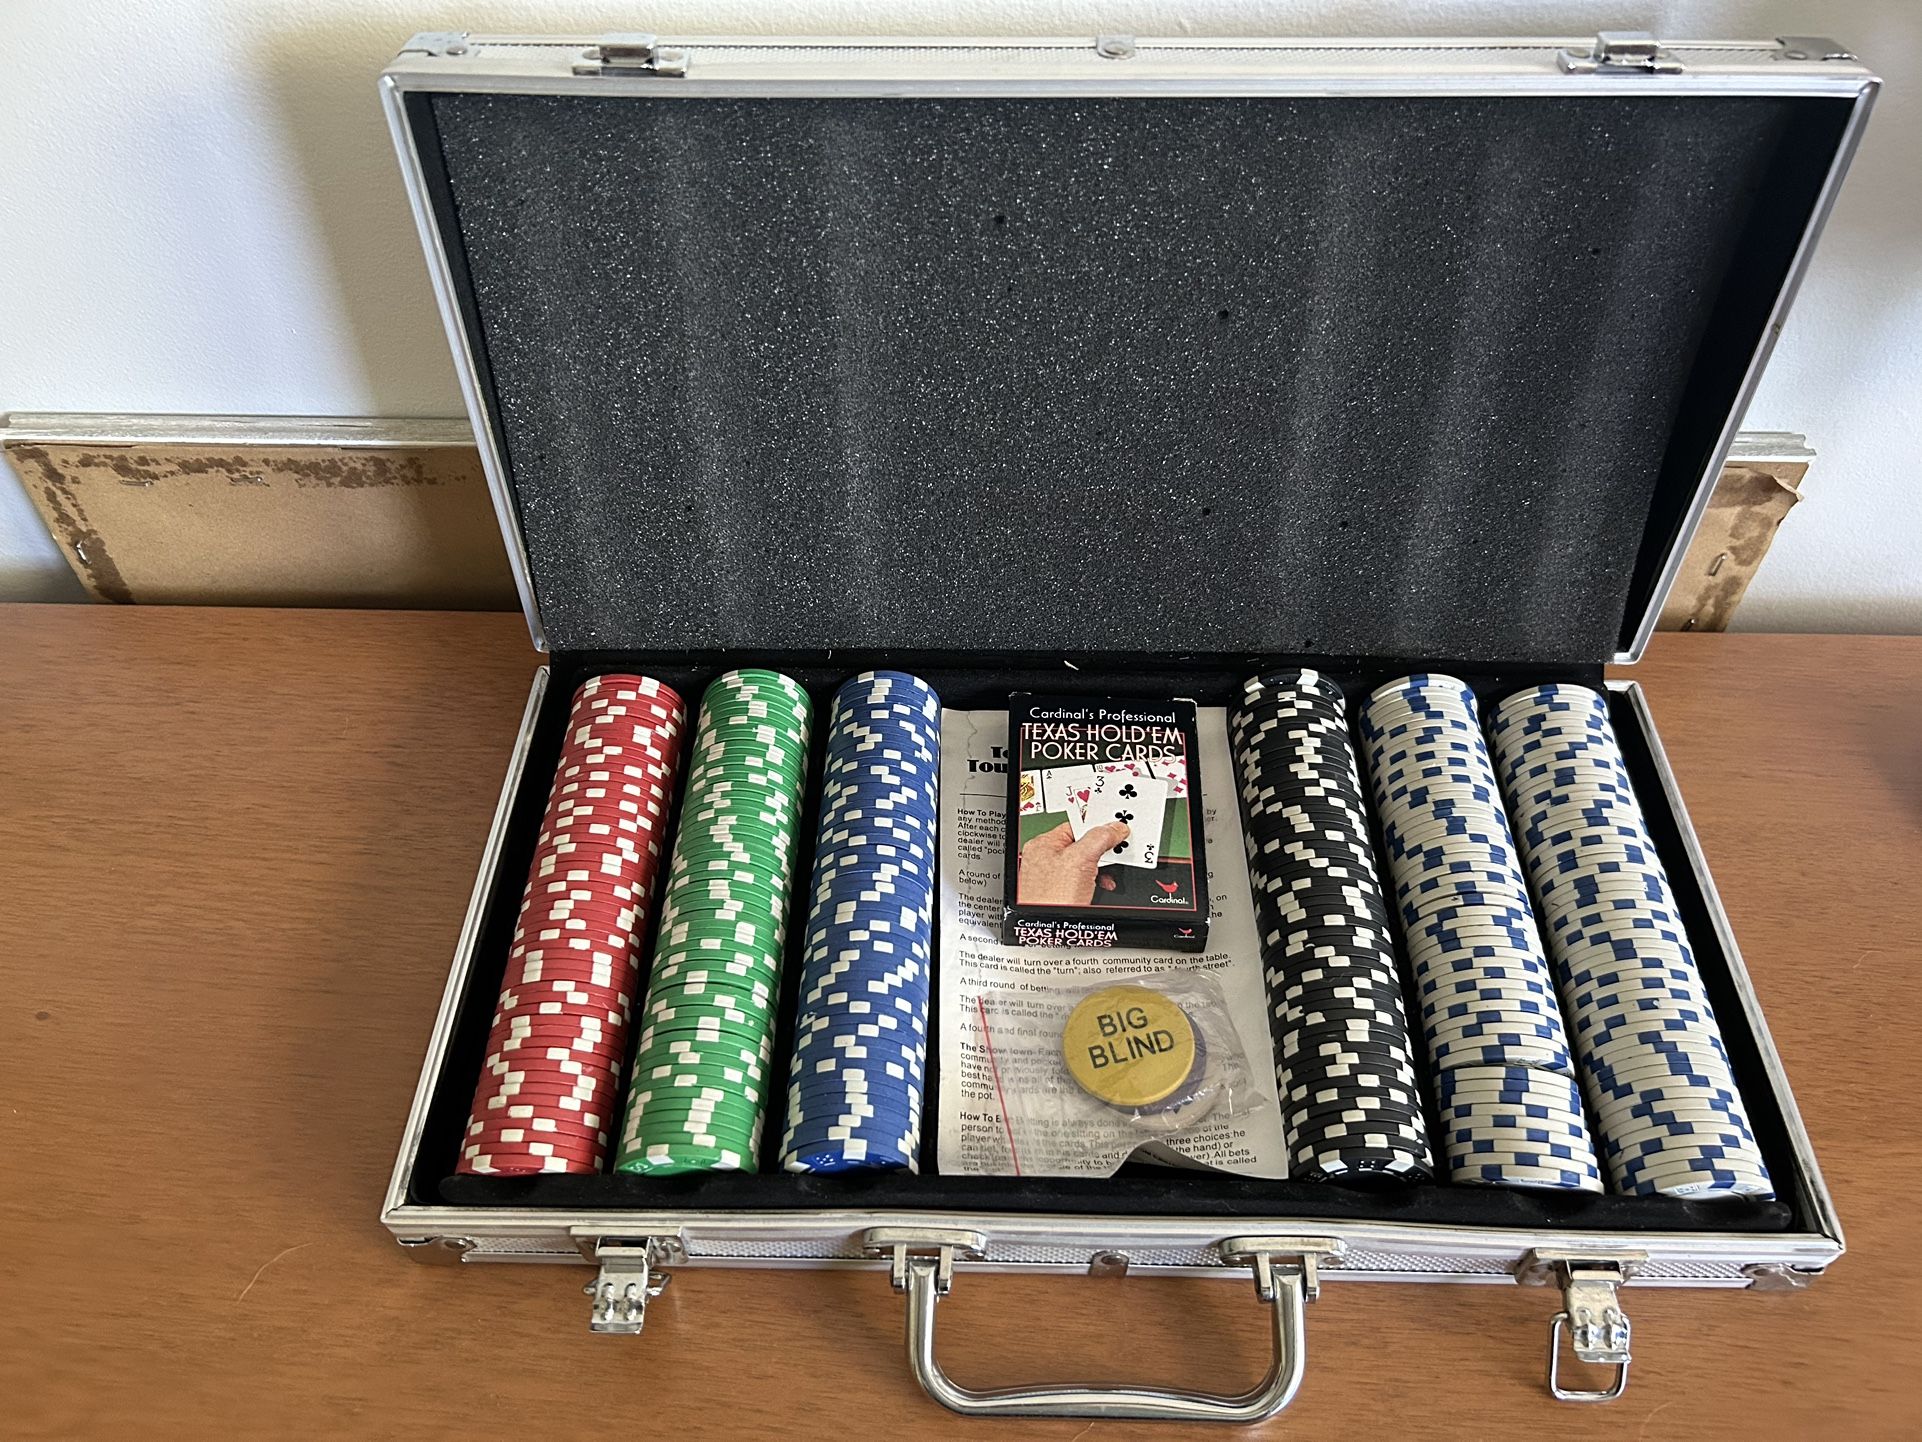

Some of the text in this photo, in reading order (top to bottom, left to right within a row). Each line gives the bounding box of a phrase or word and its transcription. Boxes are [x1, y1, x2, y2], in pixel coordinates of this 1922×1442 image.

[1029, 707, 1175, 723] Cardinal's Professional
[1022, 723, 1183, 744] TEXAS HOLD'EM
[1031, 742, 1176, 762] POKER CARDS
[967, 759, 1008, 773] Tou
[1095, 775, 1104, 787] 3
[958, 808, 975, 817] How
[958, 816, 972, 824] any
[958, 823, 977, 832] After
[979, 825, 998, 833] each
[958, 830, 997, 840] clockwise
[958, 837, 983, 846] dealer
[987, 840, 1000, 849] will
[958, 844, 982, 853] called
[967, 871, 991, 879] round
[959, 877, 987, 887] below)
[959, 893, 1002, 905] The dealer
[1150, 894, 1187, 904] Cardinal
[1216, 894, 1227, 902] on
[959, 901, 1001, 912] the center
[959, 910, 984, 919] player
[959, 918, 1002, 928] equivalent
[1017, 919, 1115, 932] Cardinal's Professional
[960, 933, 967, 941] A
[968, 935, 998, 945] second
[1014, 927, 1118, 941] TEXAS HOLD'EM
[1019, 936, 1062, 946] POKER
[1066, 938, 1113, 948] CARDS
[959, 950, 975, 960] The
[977, 953, 1004, 963] dealer
[1006, 957, 1020, 965] will
[1072, 957, 1098, 966] fourth
[1103, 957, 1151, 966] community
[1154, 957, 1173, 965] card
[1190, 956, 1204, 964] the
[1206, 953, 1231, 962] table.
[959, 958, 978, 968] This
[980, 961, 998, 970] card
[1009, 966, 1035, 974] called
[1037, 966, 1051, 974] the
[1083, 965, 1101, 974] also
[1106, 964, 1141, 974] referred
[960, 977, 967, 985] A
[968, 978, 987, 987] third
[990, 980, 1015, 989] round
[960, 994, 975, 1003] The
[1009, 999, 1023, 1008] will
[1027, 1001, 1044, 1009] turn
[960, 1003, 978, 1013] This
[1011, 1009, 1037, 1018] called
[1097, 1007, 1148, 1037] BIG
[960, 1023, 967, 1031] A
[1017, 1027, 1036, 1037] final
[960, 1042, 977, 1052] The
[1088, 1029, 1174, 1069] BLIND
[961, 1061, 982, 1071] have
[961, 1070, 980, 1081] best
[961, 1090, 996, 1101] the pot.
[960, 1111, 980, 1121] How
[982, 1113, 993, 1122] To
[961, 1123, 993, 1134] person
[1103, 1129, 1114, 1137] on
[961, 1133, 991, 1144] player
[1166, 1136, 1191, 1146] three
[1102, 1151, 1119, 1160] and
[1193, 1142, 1221, 1153] hand)
[1223, 1141, 1233, 1149] or
[1229, 1148, 1250, 1157] bets
[1227, 1155, 1257, 1165] called
